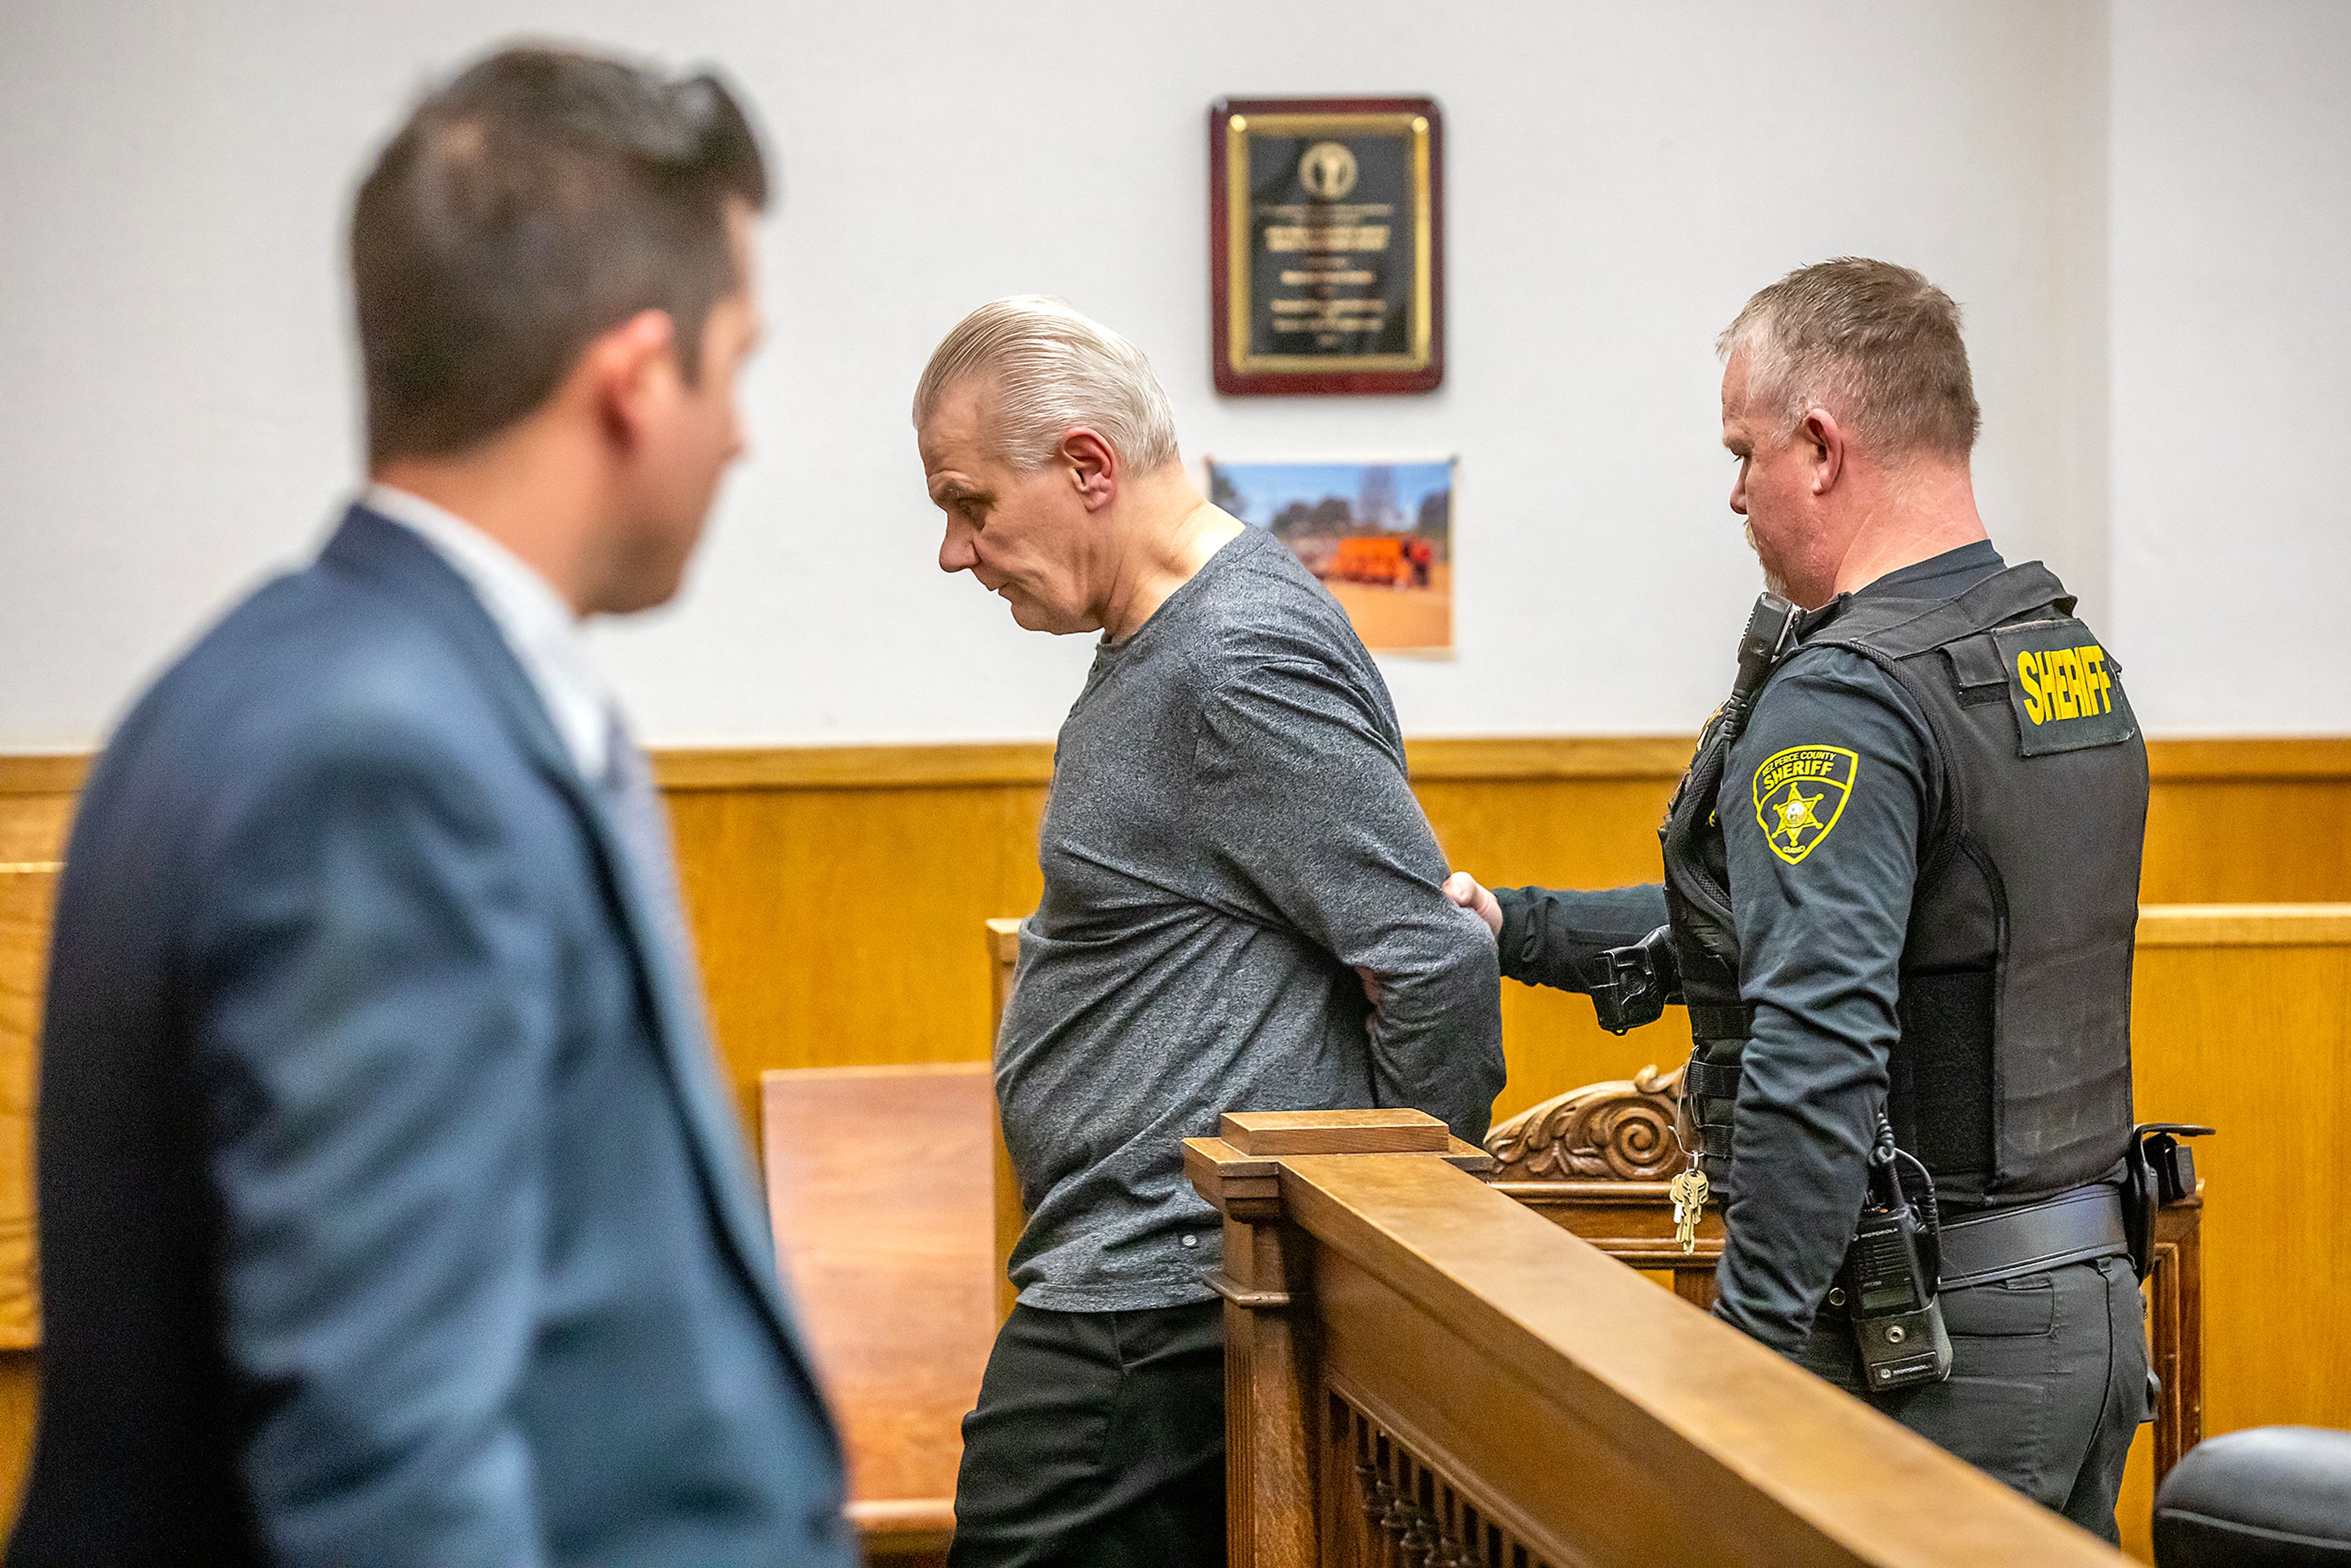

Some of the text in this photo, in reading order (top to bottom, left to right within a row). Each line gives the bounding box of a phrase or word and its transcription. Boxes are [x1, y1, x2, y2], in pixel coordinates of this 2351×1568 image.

[2017, 645, 2111, 725] SHERIFF
[1762, 751, 1837, 776] NEZ PERCE COUNTY
[1763, 760, 1834, 790] SHERIFF
[1861, 1228, 1898, 1238] MOTOROLA
